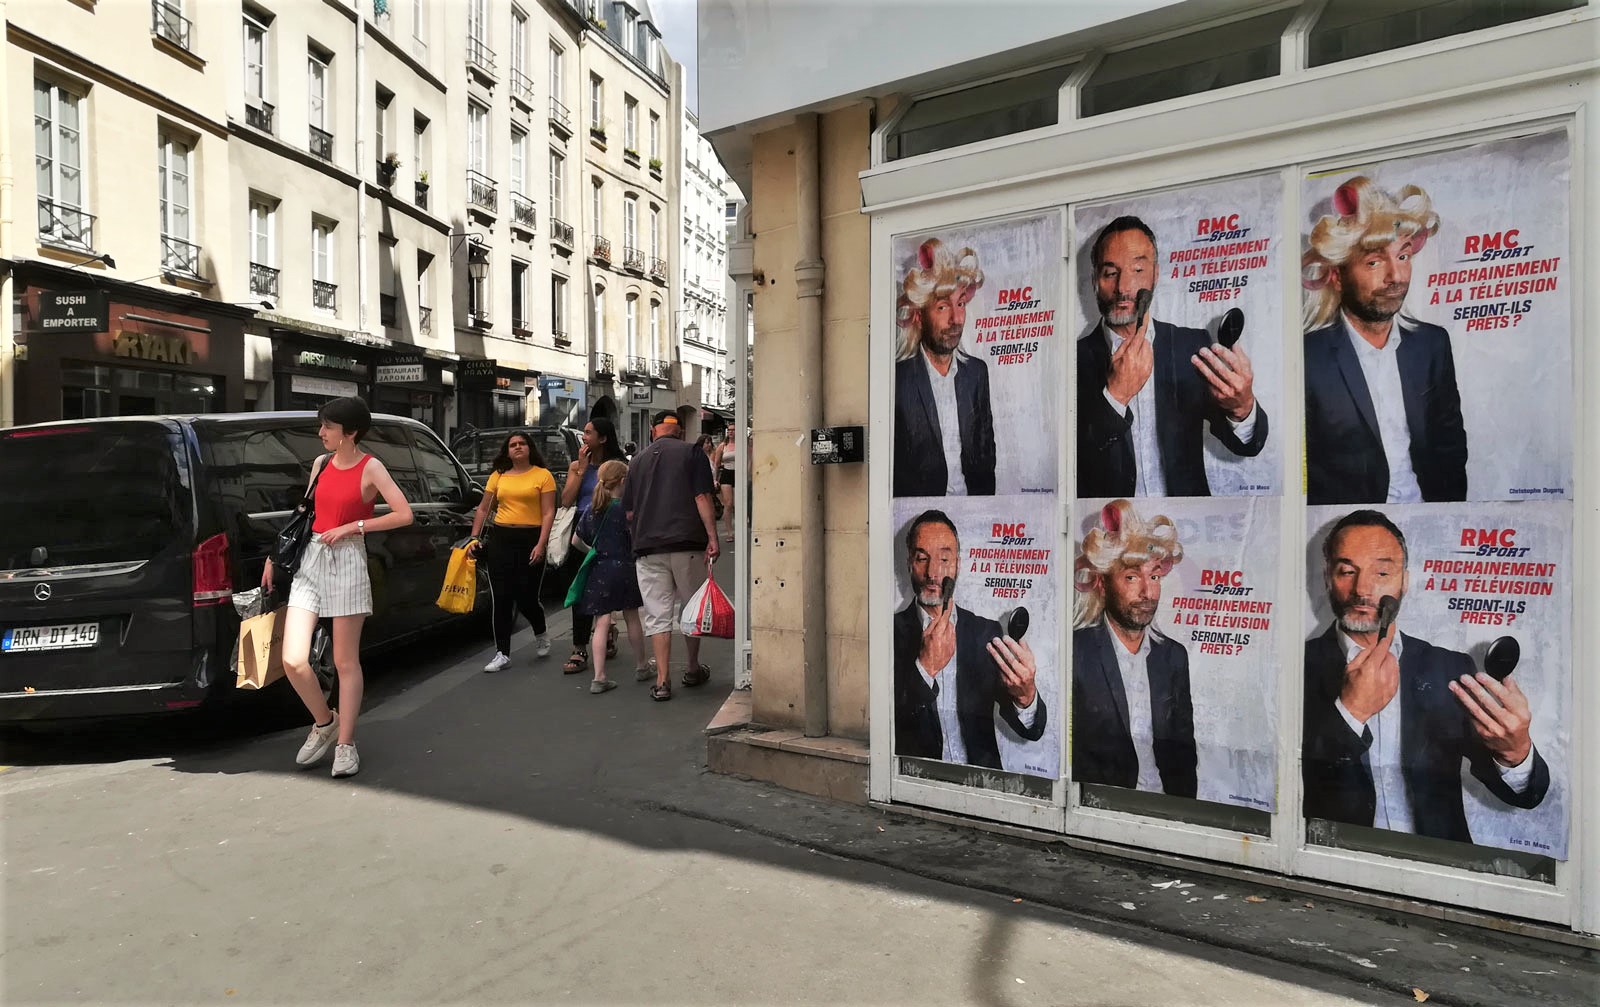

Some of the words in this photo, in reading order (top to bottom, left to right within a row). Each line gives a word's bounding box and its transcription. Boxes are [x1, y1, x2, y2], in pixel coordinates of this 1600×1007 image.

[1197, 214, 1239, 235] RMC
[1464, 229, 1520, 254] RMC
[1170, 238, 1270, 263] PROCHAINEMENT
[1183, 265, 1196, 277] LA
[1201, 256, 1267, 275] TÉLÉVISION
[1428, 257, 1560, 287] PROCHAINEMENT
[1189, 275, 1248, 292] SERONT-ILS
[1446, 289, 1462, 303] LA
[1470, 277, 1557, 300] TÉLÉVISION
[56, 296, 86, 305] SUSHI
[998, 286, 1032, 304] RMC
[1234, 288, 1241, 299] ?
[67, 307, 74, 316] A
[1454, 300, 1532, 320] SERONT-ILS
[43, 318, 97, 328] EMPORTER
[975, 310, 1055, 329] PROCHAINEMENT
[1513, 314, 1522, 327] ?
[986, 331, 997, 342] LA
[1001, 325, 1054, 340] TÉLÉVISION
[990, 342, 1039, 356] SERONT-ILS
[1026, 353, 1032, 363] ?
[377, 367, 421, 375] RESTAURANT
[380, 374, 420, 382] JAPONAIS
[992, 523, 1025, 537] RMC
[1461, 528, 1516, 547] RMC
[970, 548, 1050, 560] PROCHAINEMENT
[981, 562, 990, 573] LA
[995, 560, 1048, 575] TÉLÉVISION
[1424, 560, 1556, 577] PROCHAINEMENT
[985, 578, 1032, 588] SERONT-ILS
[1201, 570, 1243, 587] RMC
[1441, 578, 1457, 591] LA
[1464, 576, 1553, 595] TÉLÉVISION
[1021, 589, 1026, 598] ?
[1173, 597, 1272, 614] PROCHAINEMENT
[1448, 598, 1526, 613] SERONT-ILS
[1186, 613, 1199, 625] LA
[1204, 612, 1270, 630] TÉLÉVISION
[1507, 614, 1516, 626] ?
[12, 629, 40, 646] ARN
[50, 627, 68, 643] DT
[70, 625, 97, 642] 140
[1191, 631, 1250, 645] SERONT-ILS
[1236, 645, 1243, 655] ?
